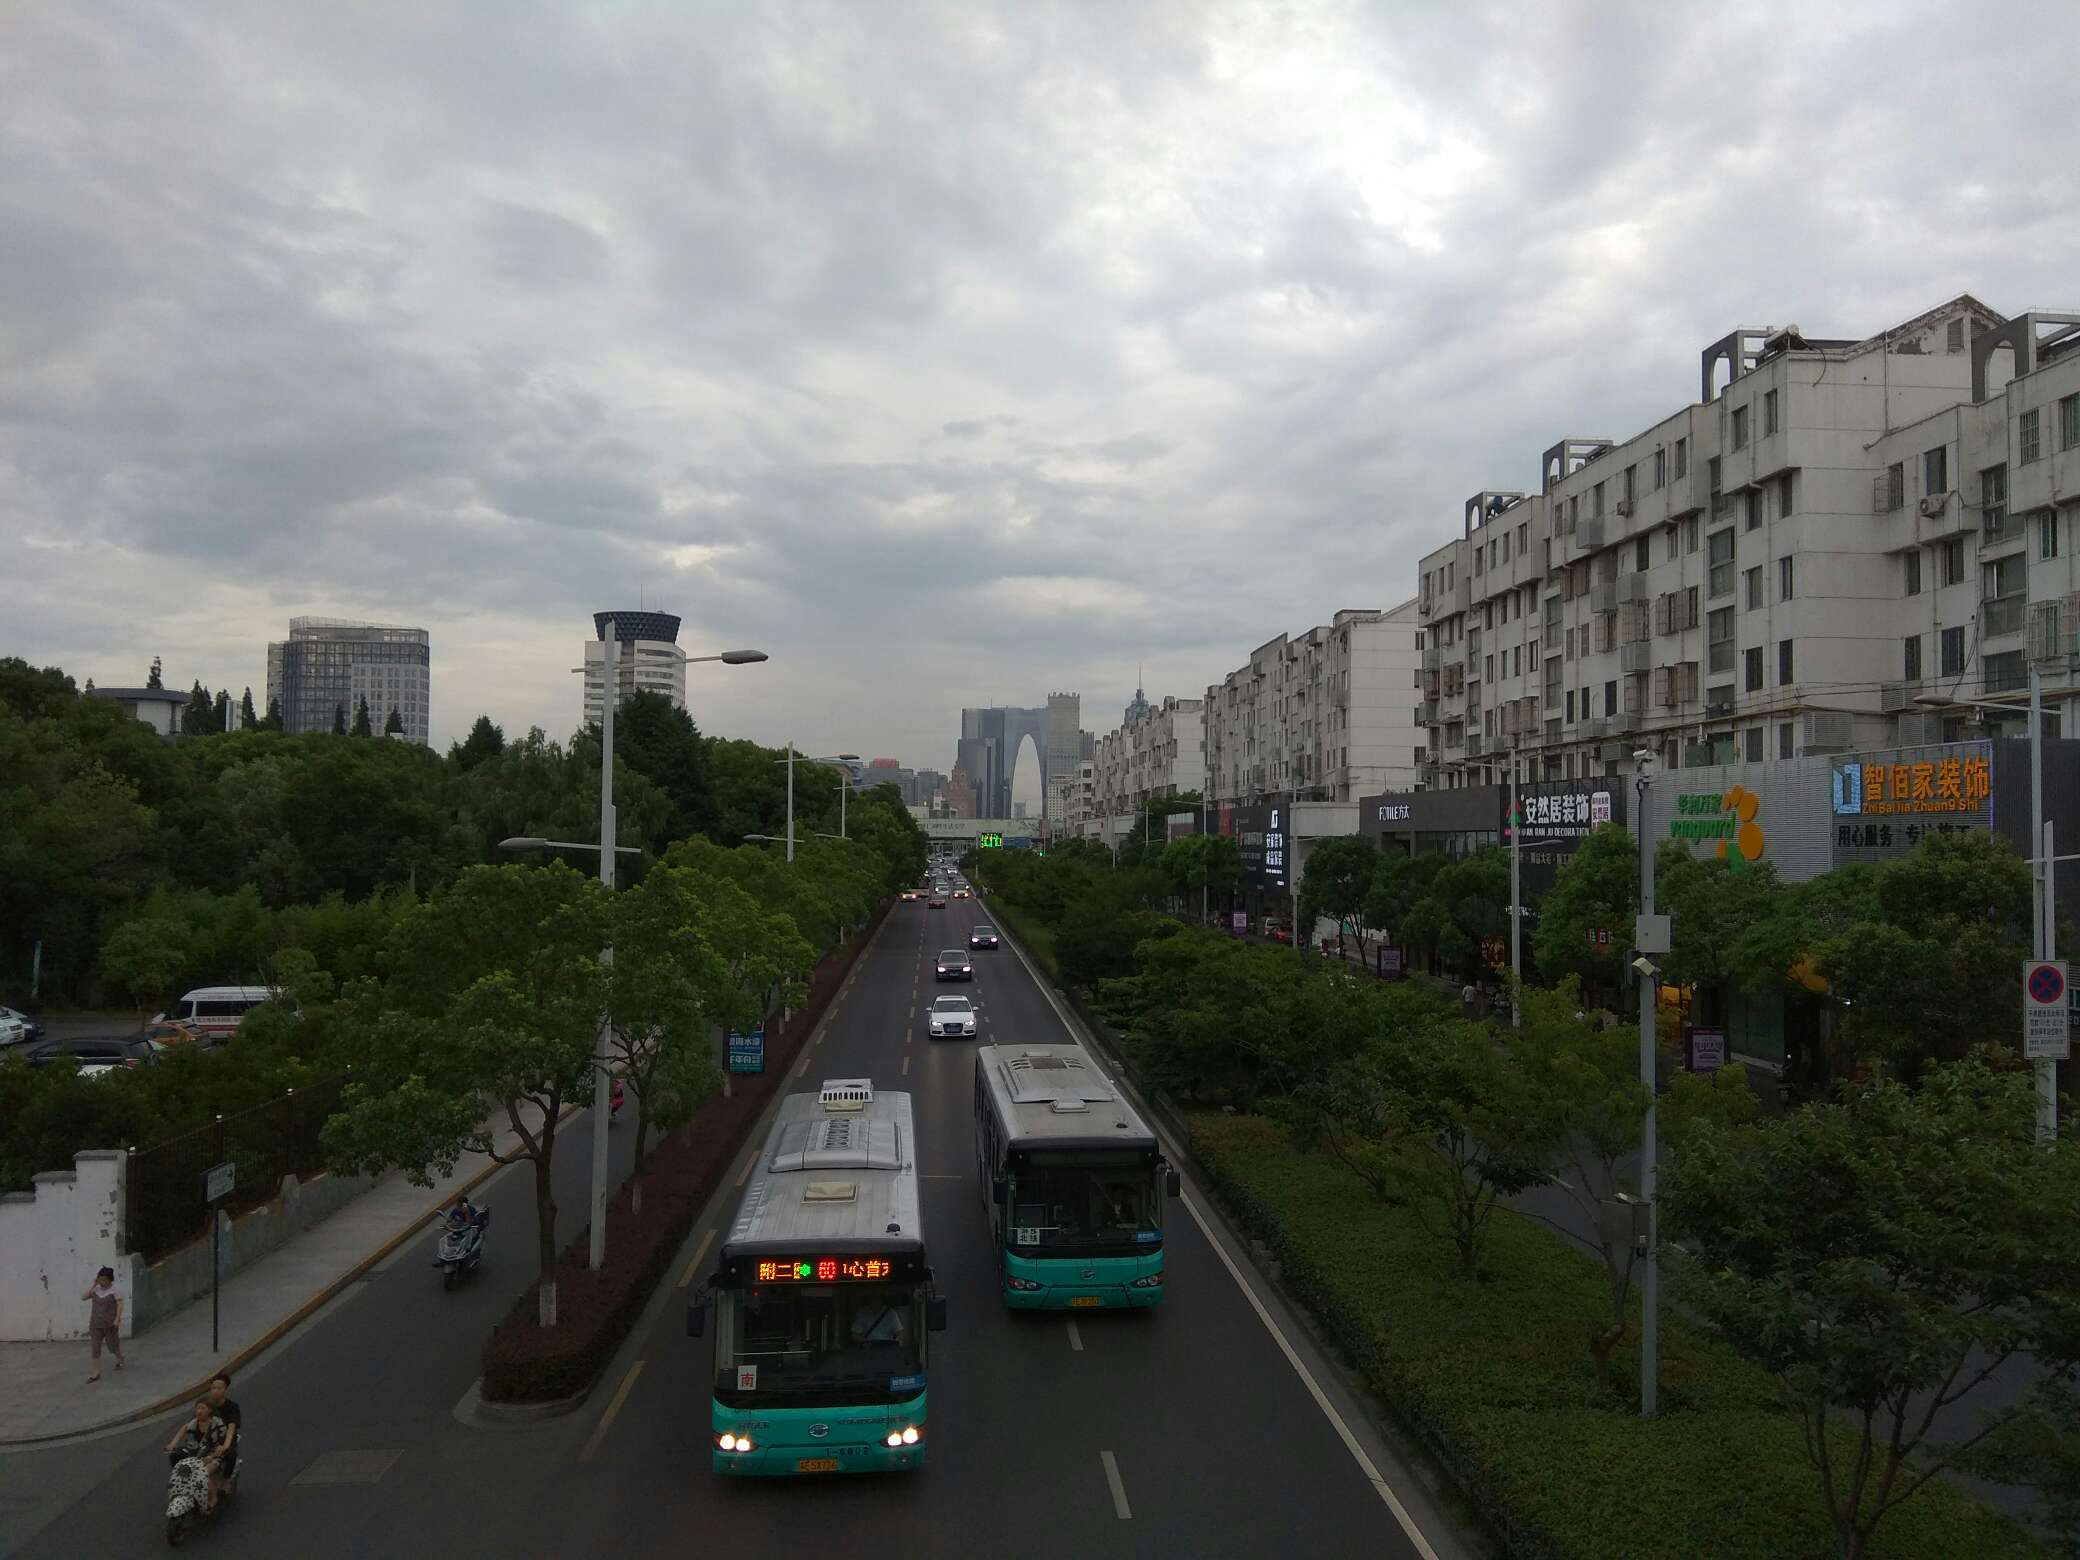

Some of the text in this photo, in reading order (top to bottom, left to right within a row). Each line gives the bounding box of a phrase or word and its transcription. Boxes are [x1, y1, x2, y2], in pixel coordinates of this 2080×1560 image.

[1525, 793, 1589, 825] 安然居装饰
